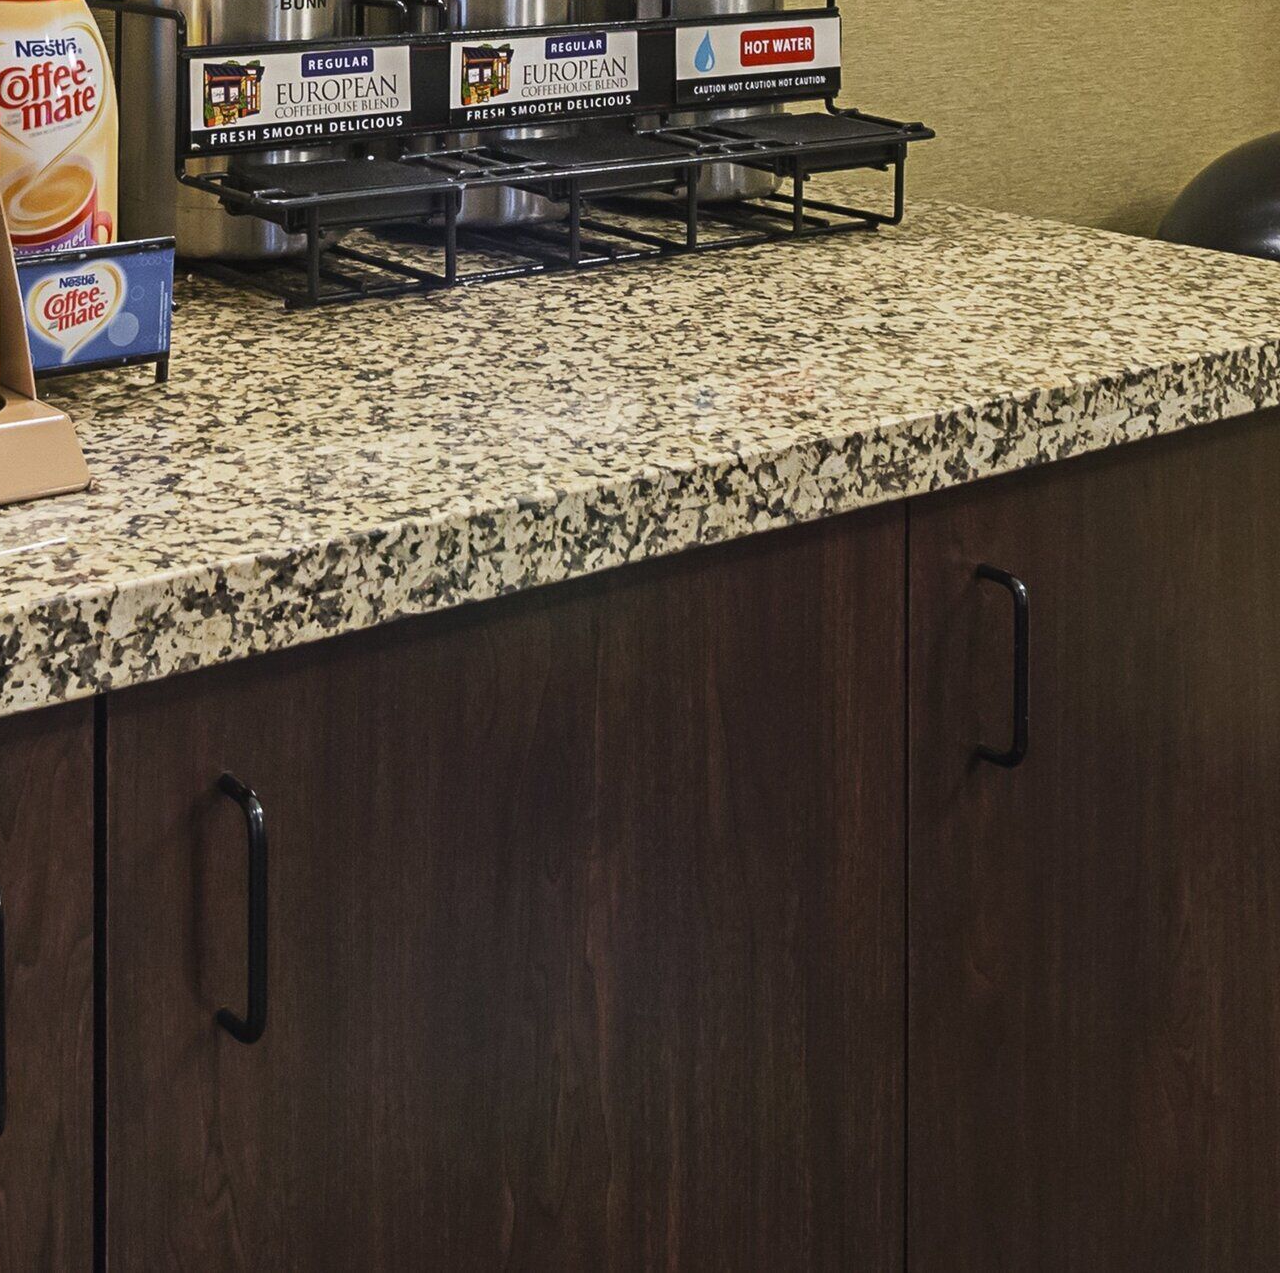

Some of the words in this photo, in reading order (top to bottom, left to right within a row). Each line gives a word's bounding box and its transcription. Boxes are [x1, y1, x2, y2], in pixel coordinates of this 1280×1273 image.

[15, 37, 77, 58] Nestlé
[551, 39, 602, 53] REGULAR
[744, 40, 770, 55] HOT
[772, 36, 812, 52] WATER
[308, 55, 368, 70] REGULAR
[523, 56, 627, 85] EUROPEAN
[276, 74, 397, 105] EUROPEAN
[521, 83, 592, 98] COFFEEHOUSE
[595, 77, 629, 90] BLEND
[693, 84, 726, 95] CAUTION
[728, 82, 743, 91] HOT
[744, 79, 776, 90] CAUTION
[778, 78, 792, 87] HOT
[794, 75, 826, 86] CAUTION
[21, 85, 96, 131] mate
[274, 102, 358, 119] COFFEEHOUSE
[361, 97, 399, 111] BLEND
[466, 108, 505, 121] FRESH
[511, 102, 562, 116] SMOOTH
[567, 94, 632, 110] DELICIOUS
[210, 130, 256, 145] FRESH
[263, 123, 323, 139] SMOOTH
[329, 115, 403, 132] DELICIOUS
[58, 301, 105, 332] mate
